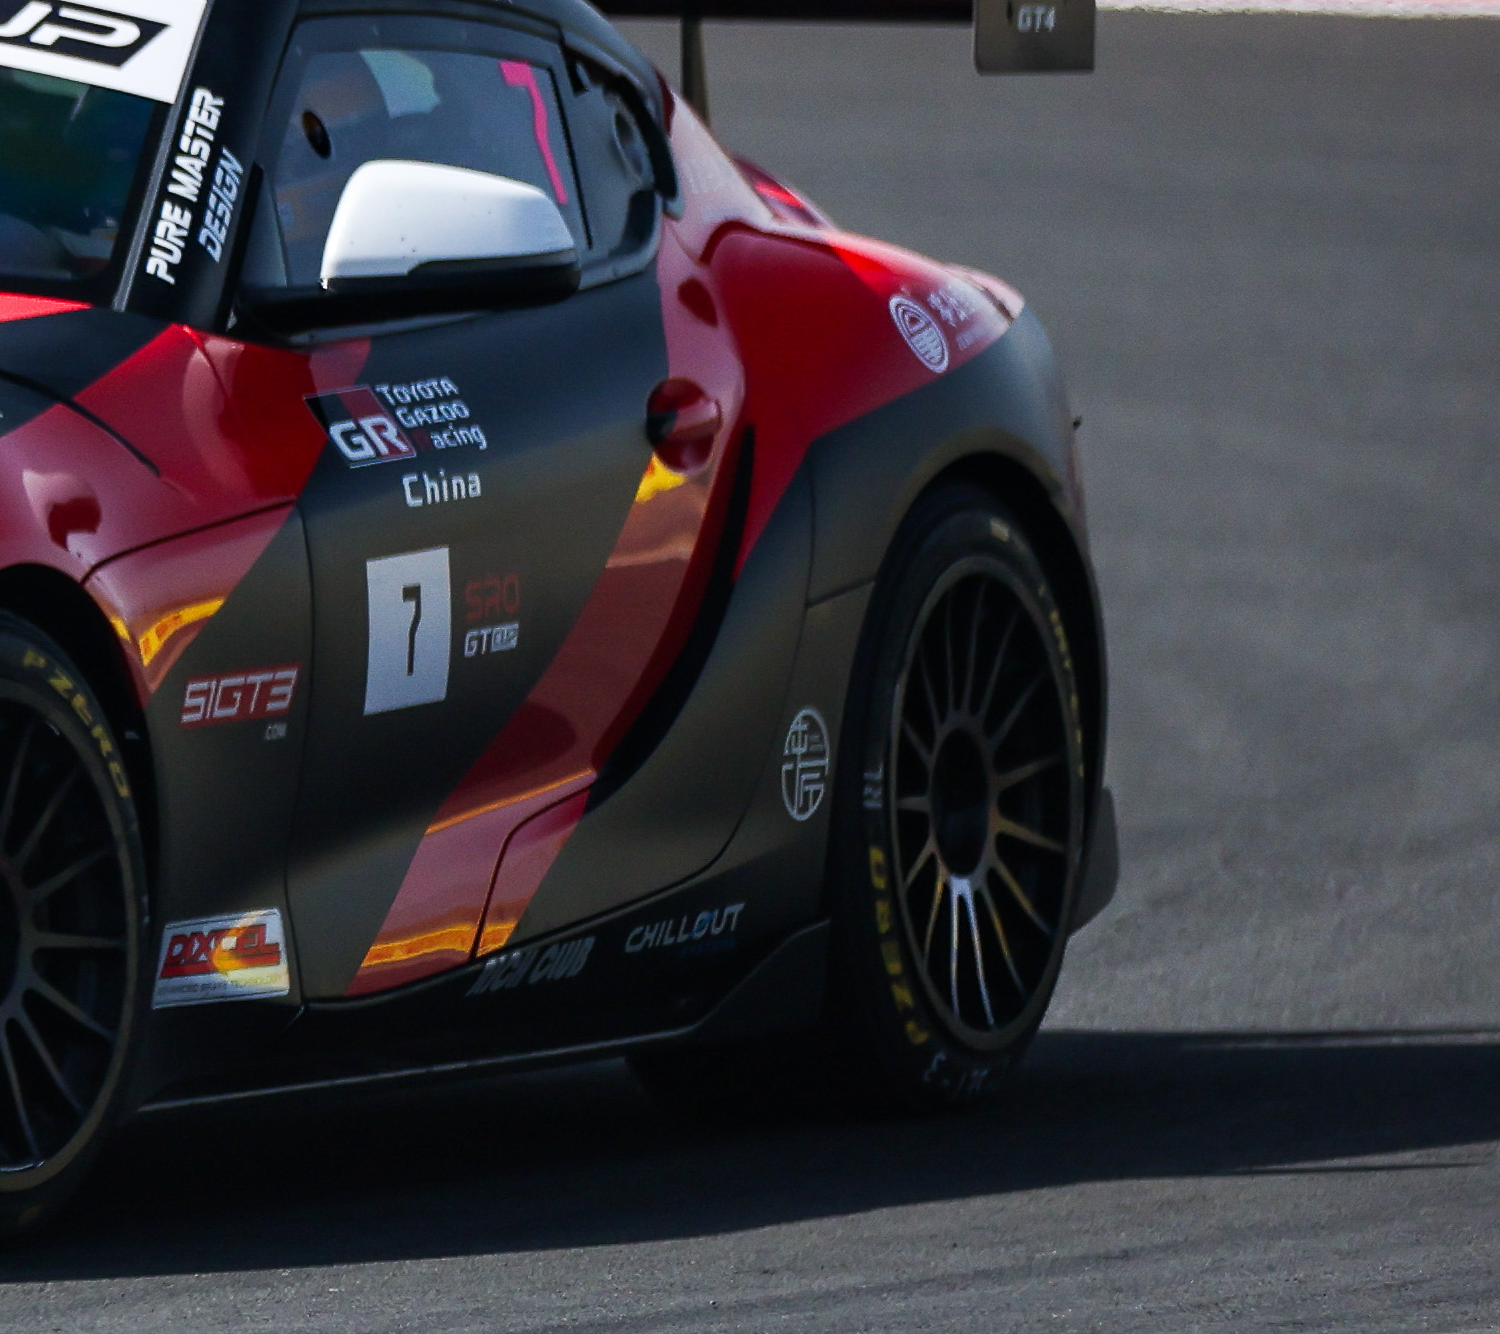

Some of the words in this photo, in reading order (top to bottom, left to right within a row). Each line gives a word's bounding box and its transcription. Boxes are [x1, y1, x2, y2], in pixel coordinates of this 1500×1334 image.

[167, 85, 225, 204] MASTER
[501, 58, 569, 206] 7
[198, 145, 244, 263] DESIGN
[145, 199, 193, 286] PURE
[374, 376, 460, 406] TOYOTA
[395, 399, 471, 428] GAZOO
[328, 415, 409, 462] GR
[402, 468, 483, 508] China
[465, 572, 521, 621] SRO
[402, 584, 422, 677] 7
[162, 923, 281, 978] DIXCEL
[624, 901, 746, 954] CHILLOUT
